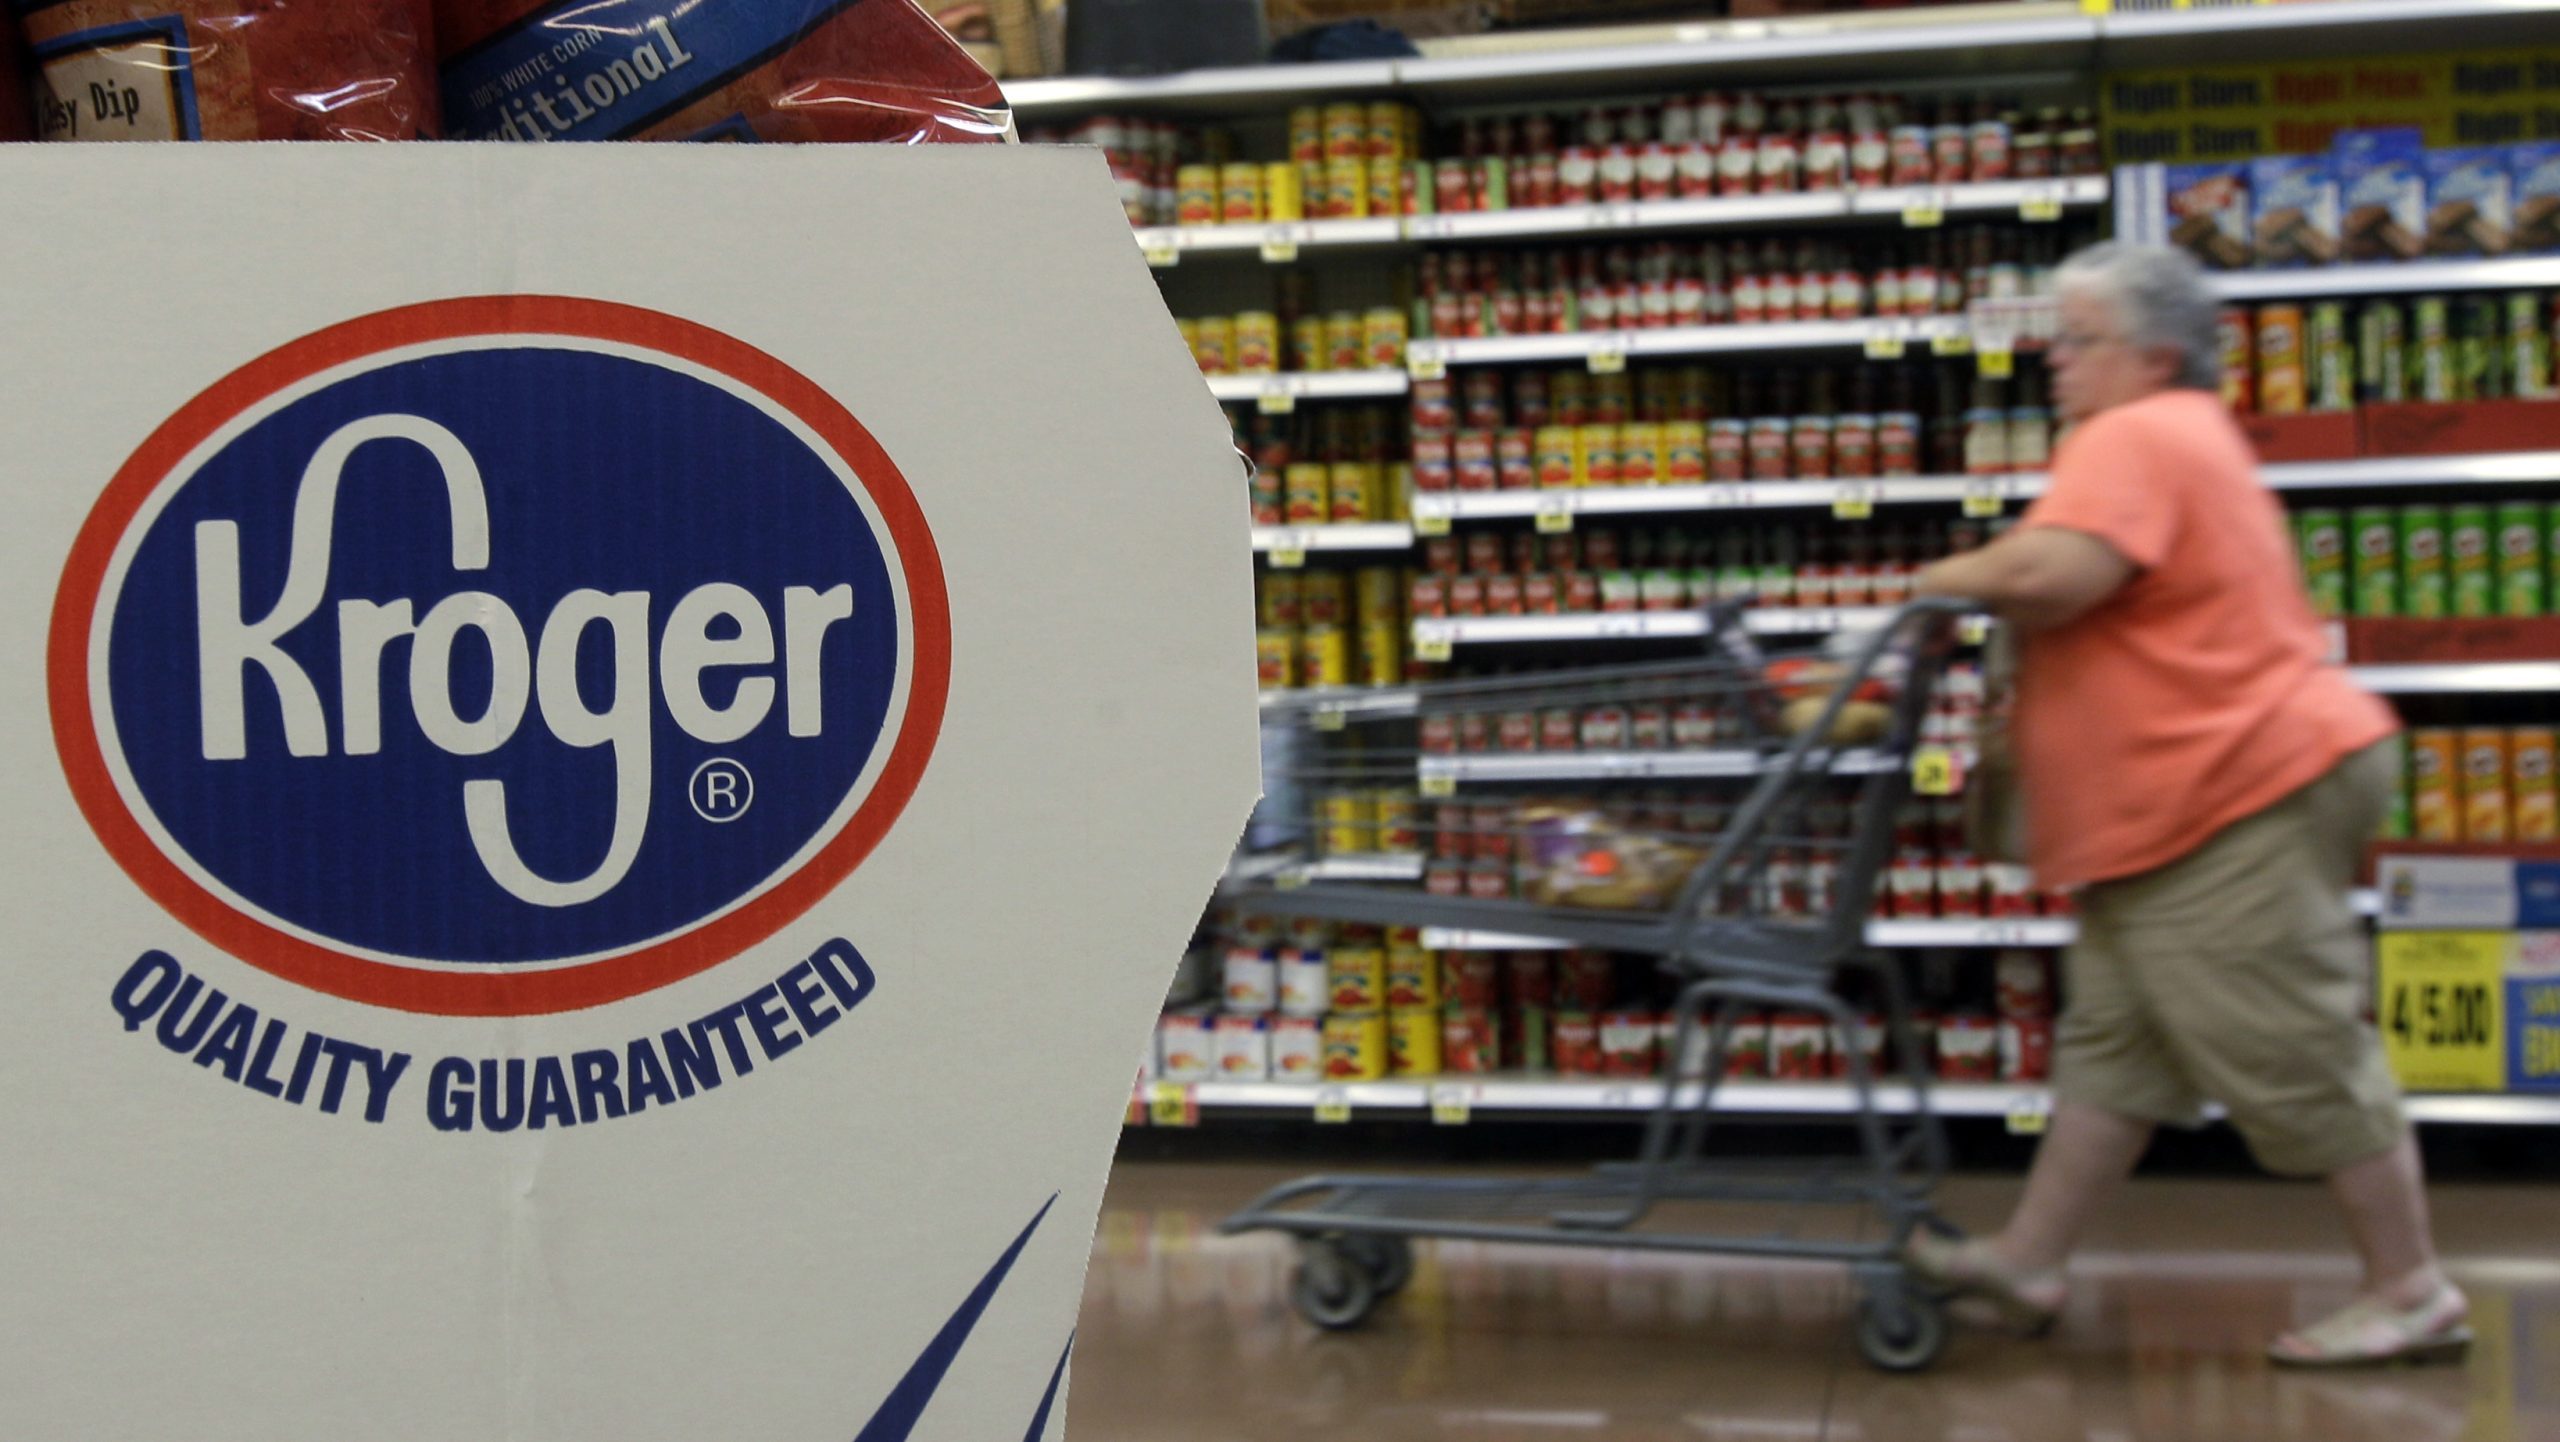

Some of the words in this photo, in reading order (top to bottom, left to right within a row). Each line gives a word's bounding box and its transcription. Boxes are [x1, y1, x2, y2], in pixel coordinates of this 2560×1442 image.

[89, 79, 140, 126] Dip
[501, 52, 555, 92] WHITE
[552, 26, 603, 65] CORN
[195, 413, 853, 908] Kroger
[112, 949, 413, 1122] QUALITY
[428, 937, 877, 1133] GUARANTEED
